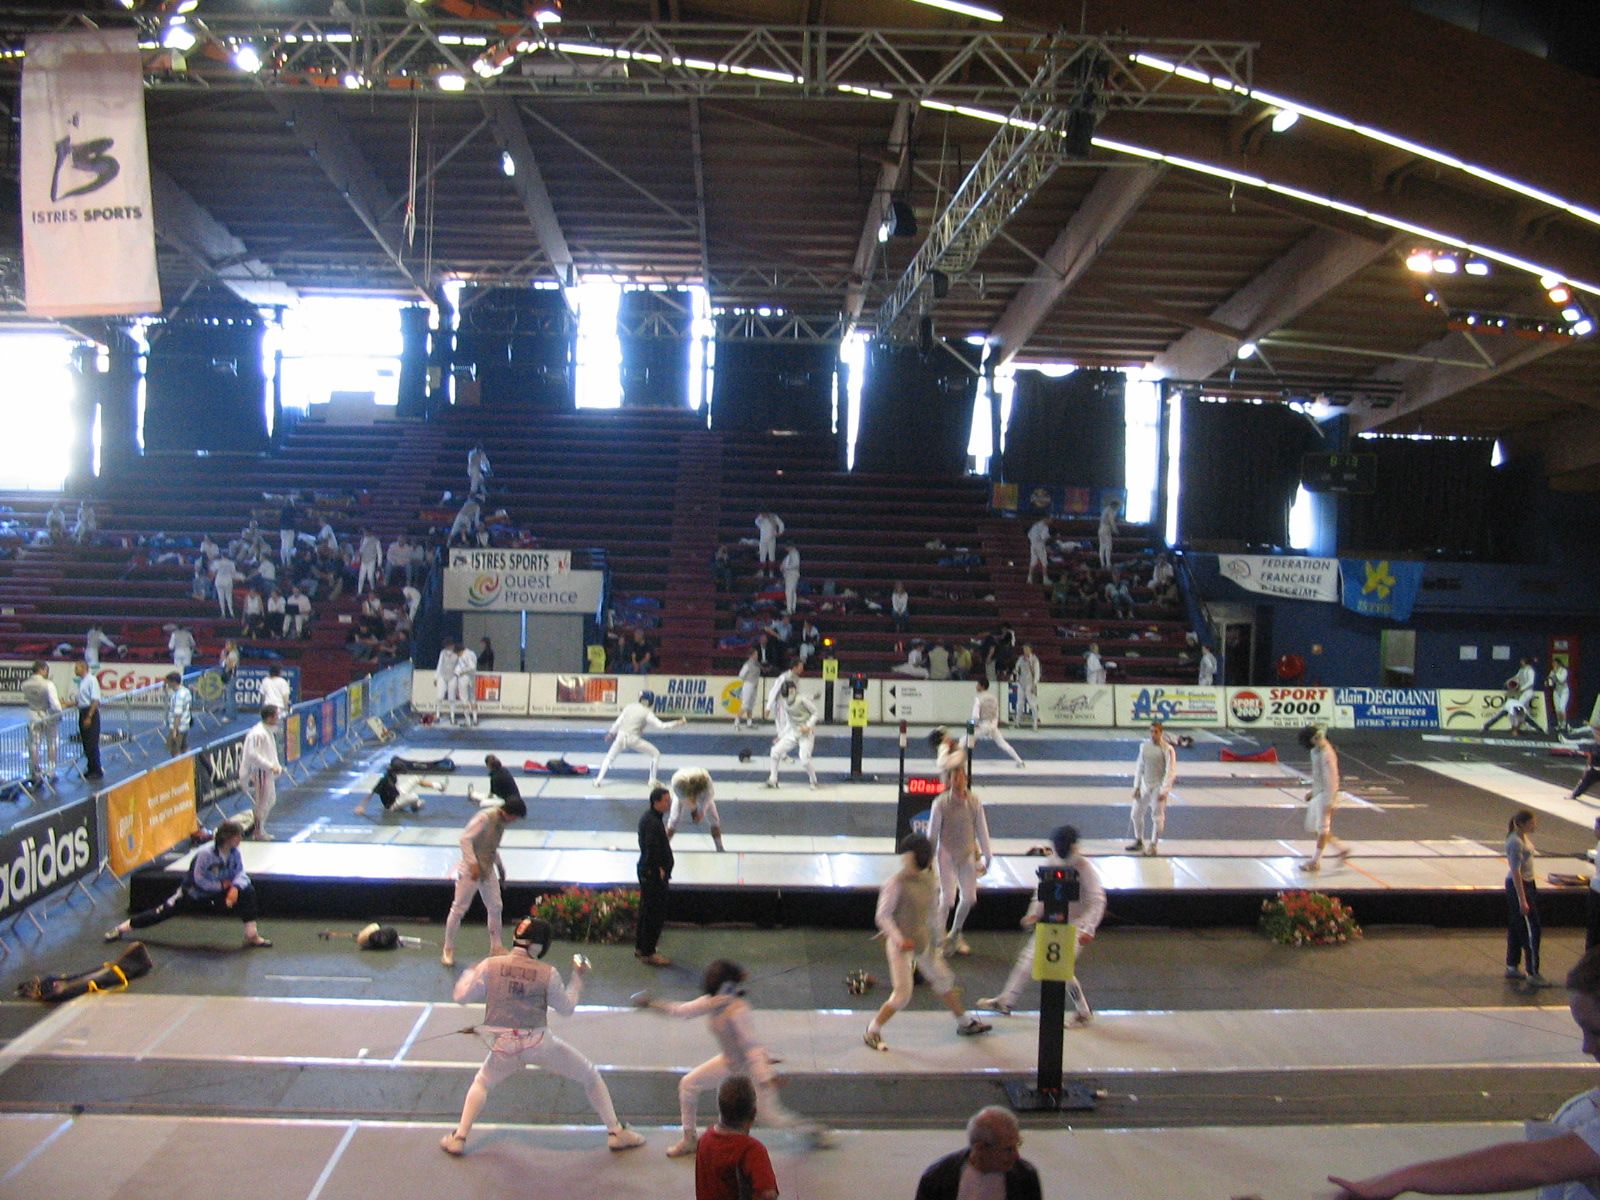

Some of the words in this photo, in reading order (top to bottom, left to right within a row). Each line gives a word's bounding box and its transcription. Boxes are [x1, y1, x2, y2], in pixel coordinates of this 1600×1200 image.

[31, 208, 78, 224] ISTRES
[83, 205, 143, 222] SPORTS
[471, 551, 506, 571] ISTRES
[508, 553, 550, 571] SPORTS
[1261, 557, 1331, 571] FEDERATION
[504, 573, 552, 589] Ouest
[504, 590, 579, 604] Provence
[667, 679, 707, 694] RADIO
[1269, 688, 1328, 700] SPORT
[1336, 687, 1363, 704] Alain
[1366, 688, 1436, 706] DEGIOANNI
[653, 695, 715, 714] MARITIMA
[1271, 702, 1321, 715] 2000
[1366, 704, 1427, 717] Assurances
[851, 709, 866, 719] 12
[1045, 942, 1061, 963] 8
